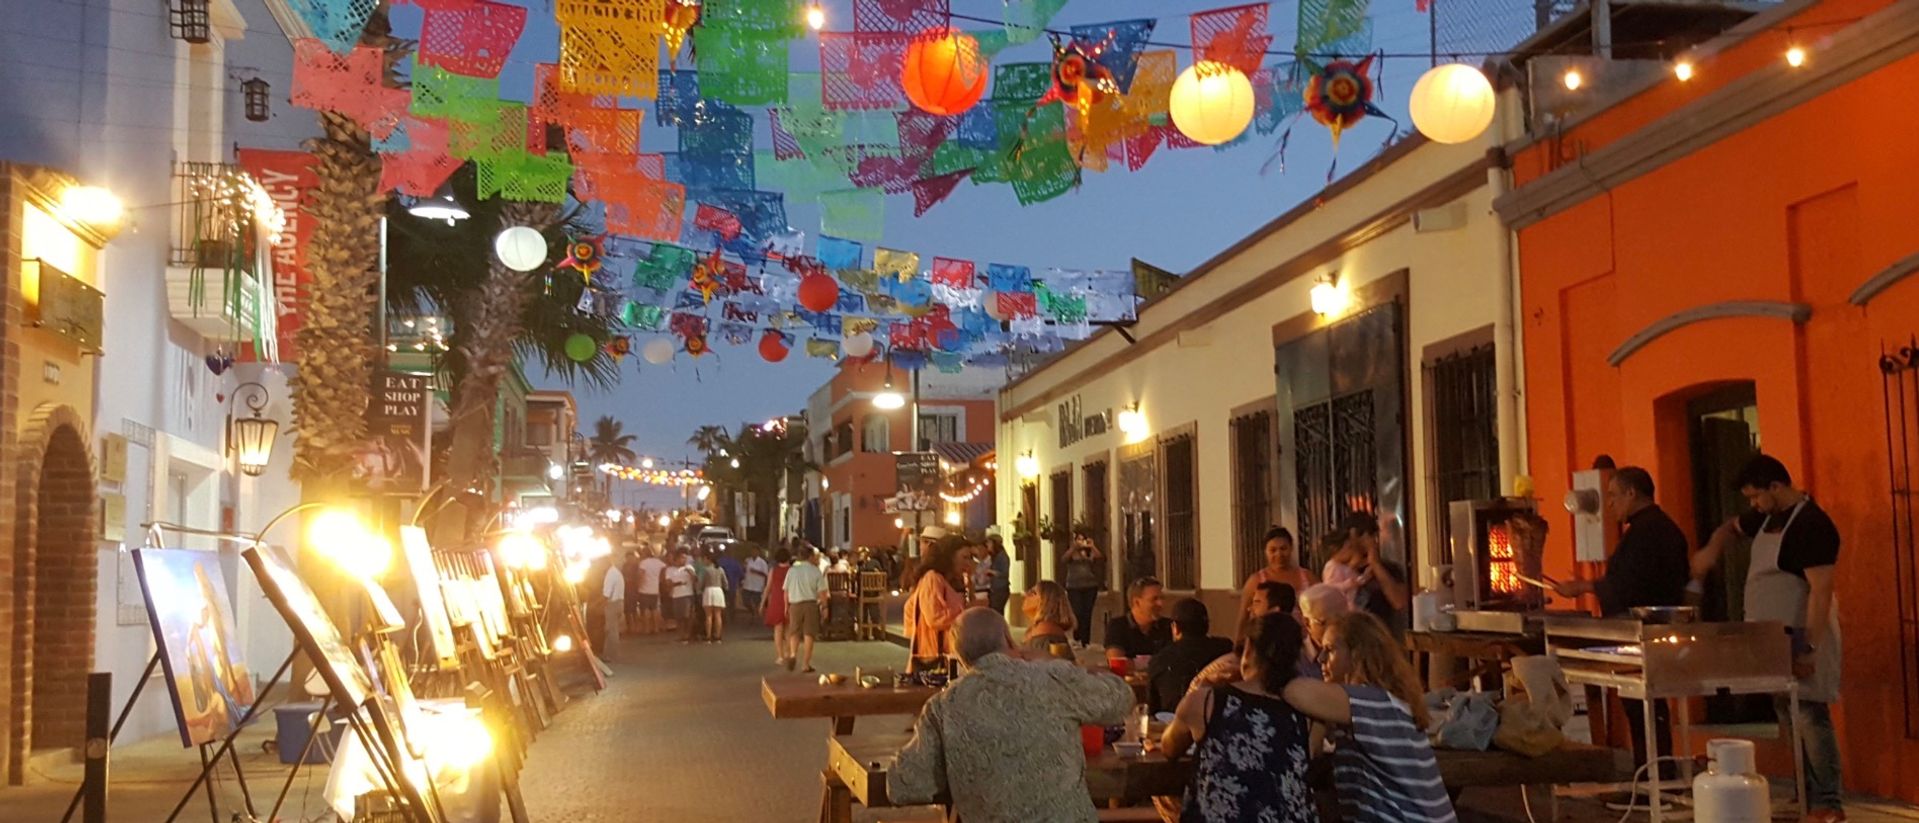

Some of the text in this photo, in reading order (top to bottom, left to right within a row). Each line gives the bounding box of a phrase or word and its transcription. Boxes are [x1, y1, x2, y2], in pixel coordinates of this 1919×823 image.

[385, 377, 421, 389] EAT
[384, 391, 421, 403] SHOP
[384, 404, 418, 416] PLAY
